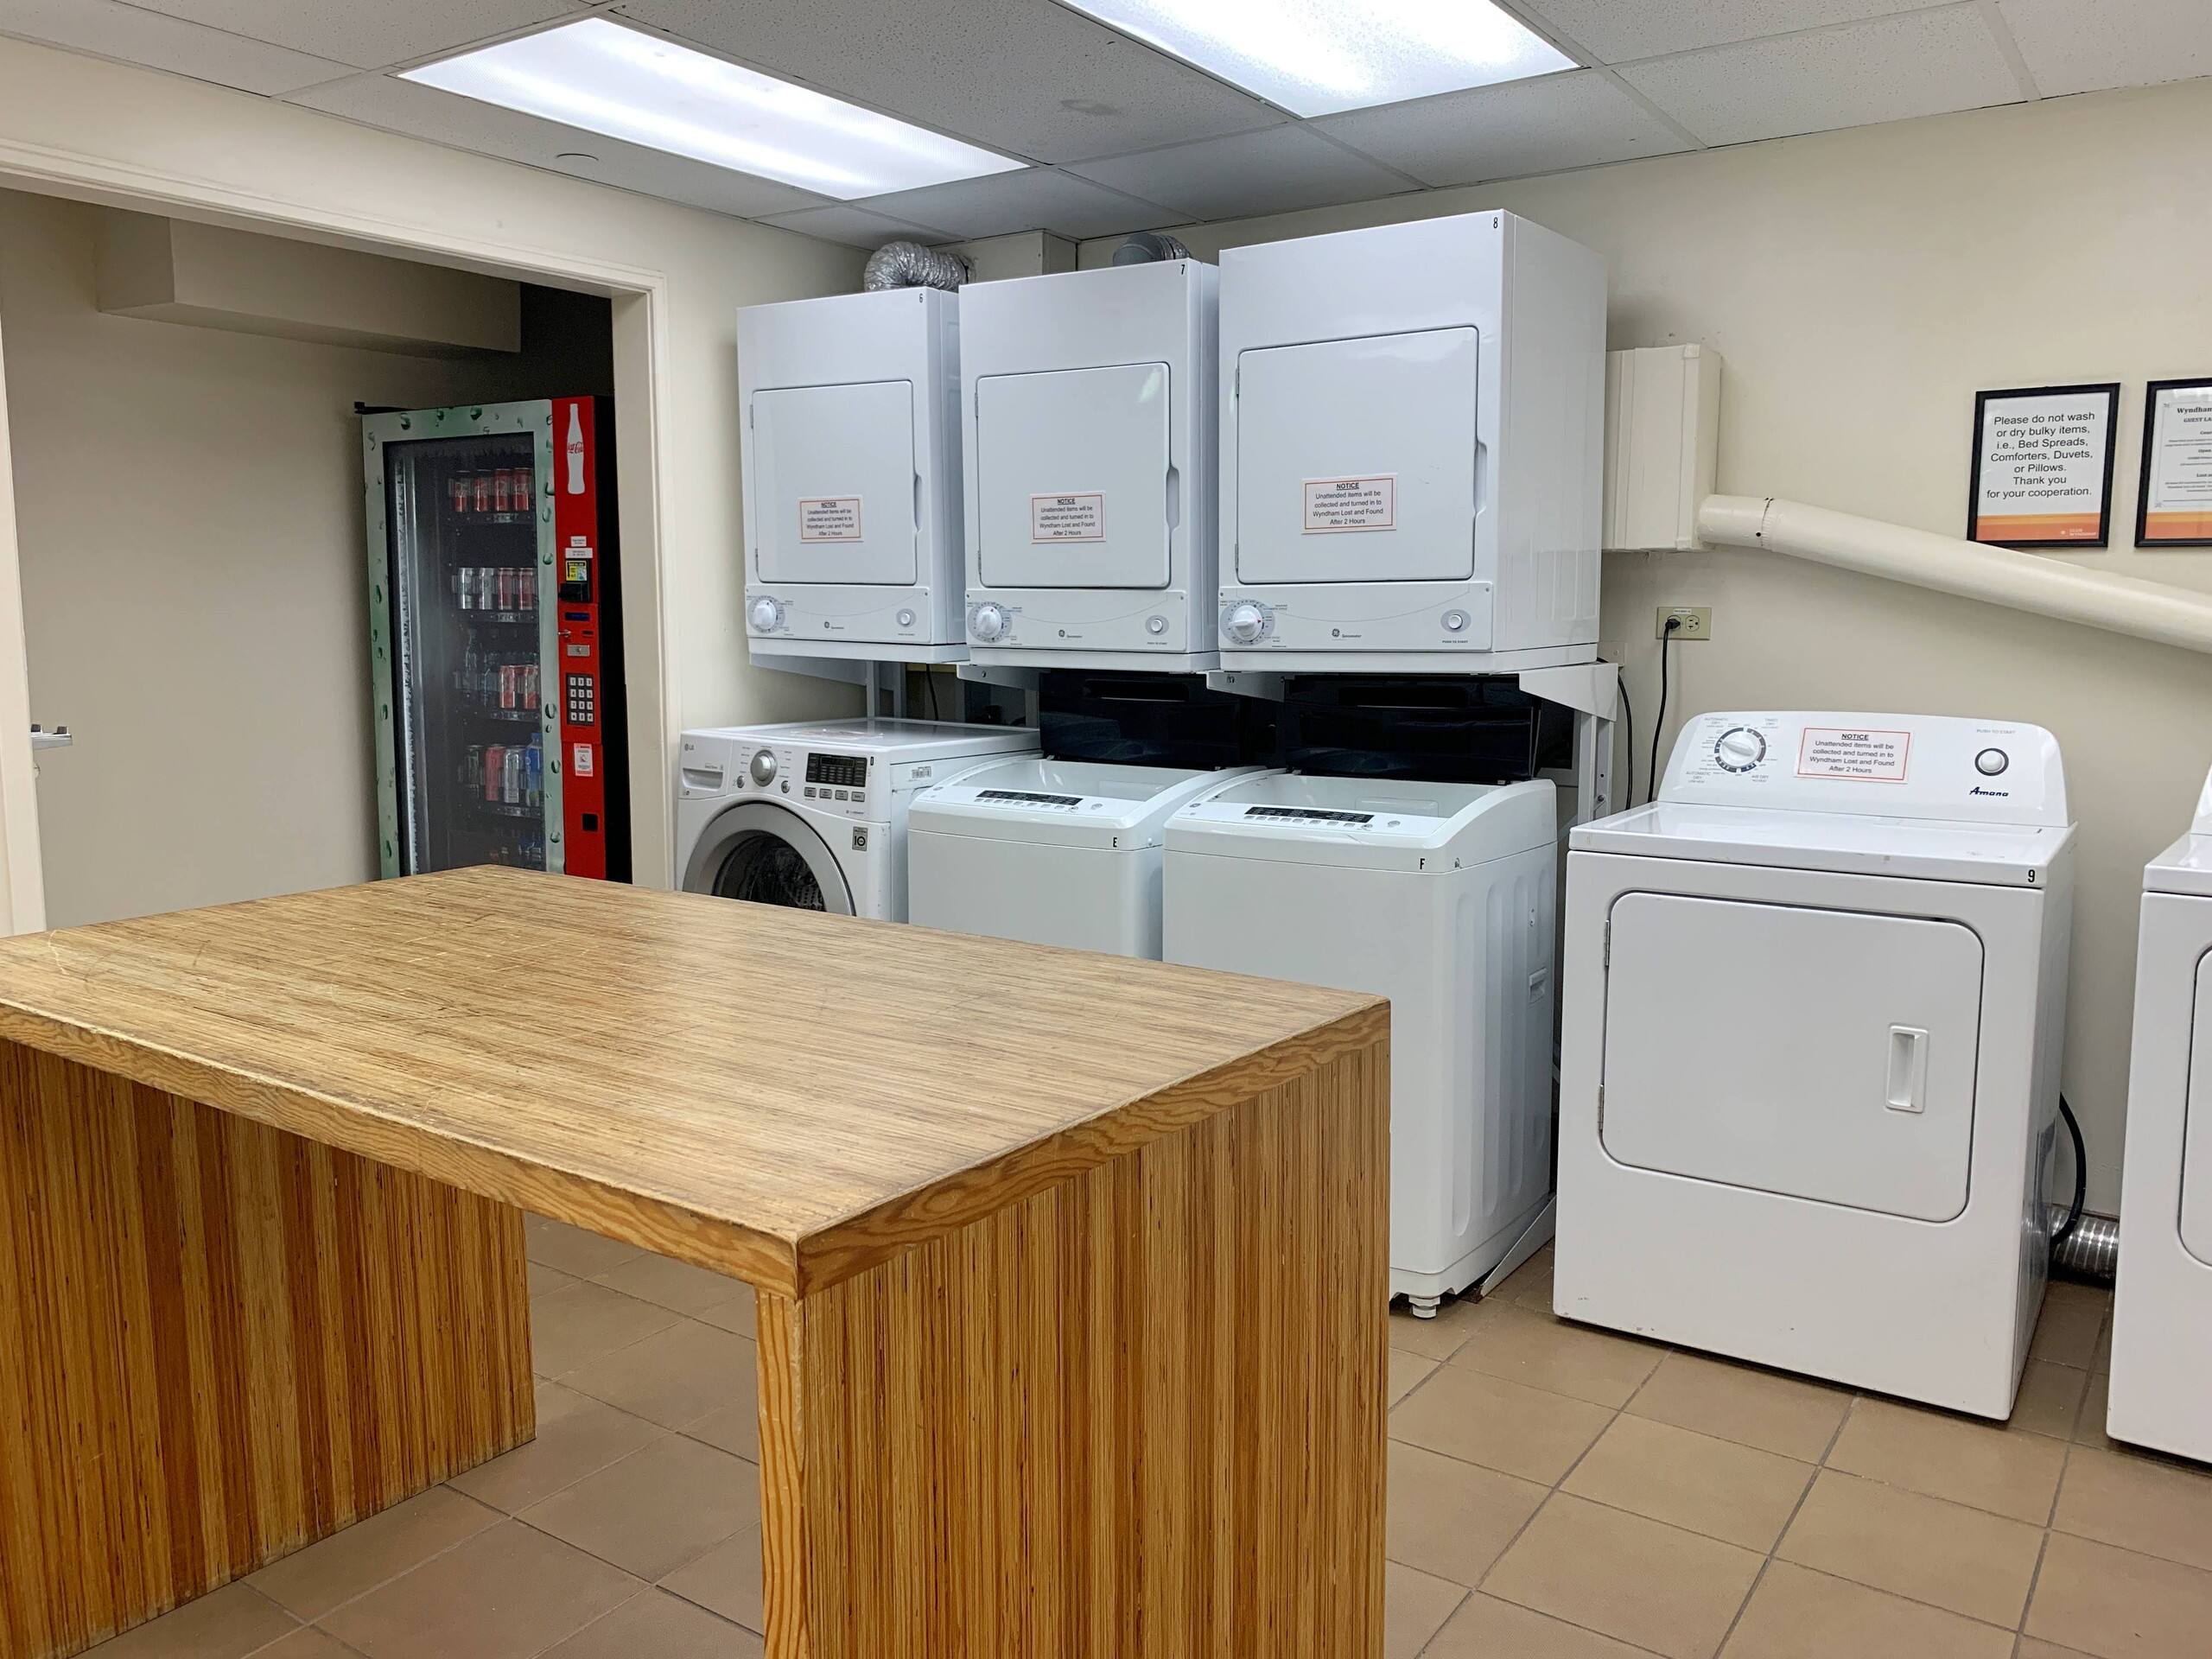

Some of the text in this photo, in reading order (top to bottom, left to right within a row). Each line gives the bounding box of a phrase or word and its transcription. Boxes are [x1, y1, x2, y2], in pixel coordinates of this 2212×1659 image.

[1494, 217, 1498, 229] 8
[1181, 264, 1185, 275] 7
[919, 293, 923, 303] 6
[1994, 417, 2028, 425] Please
[2048, 414, 2064, 422] not
[2068, 412, 2095, 421] wash
[2010, 429, 2025, 438] dry
[2029, 427, 2055, 437] bulky
[2059, 426, 2090, 434] items,
[2019, 440, 2038, 448] Bed
[2042, 438, 2088, 448] Spreads,
[1991, 451, 2093, 462] Comforters, Duvets,
[2028, 464, 2066, 472] Pillows.
[2013, 476, 2066, 486] Thank you
[1987, 488, 2091, 500] for your cooperation.
[1969, 786, 2009, 796] Amana
[1113, 837, 1117, 847] E
[1420, 858, 1425, 870] F
[2028, 869, 2035, 883] 9
